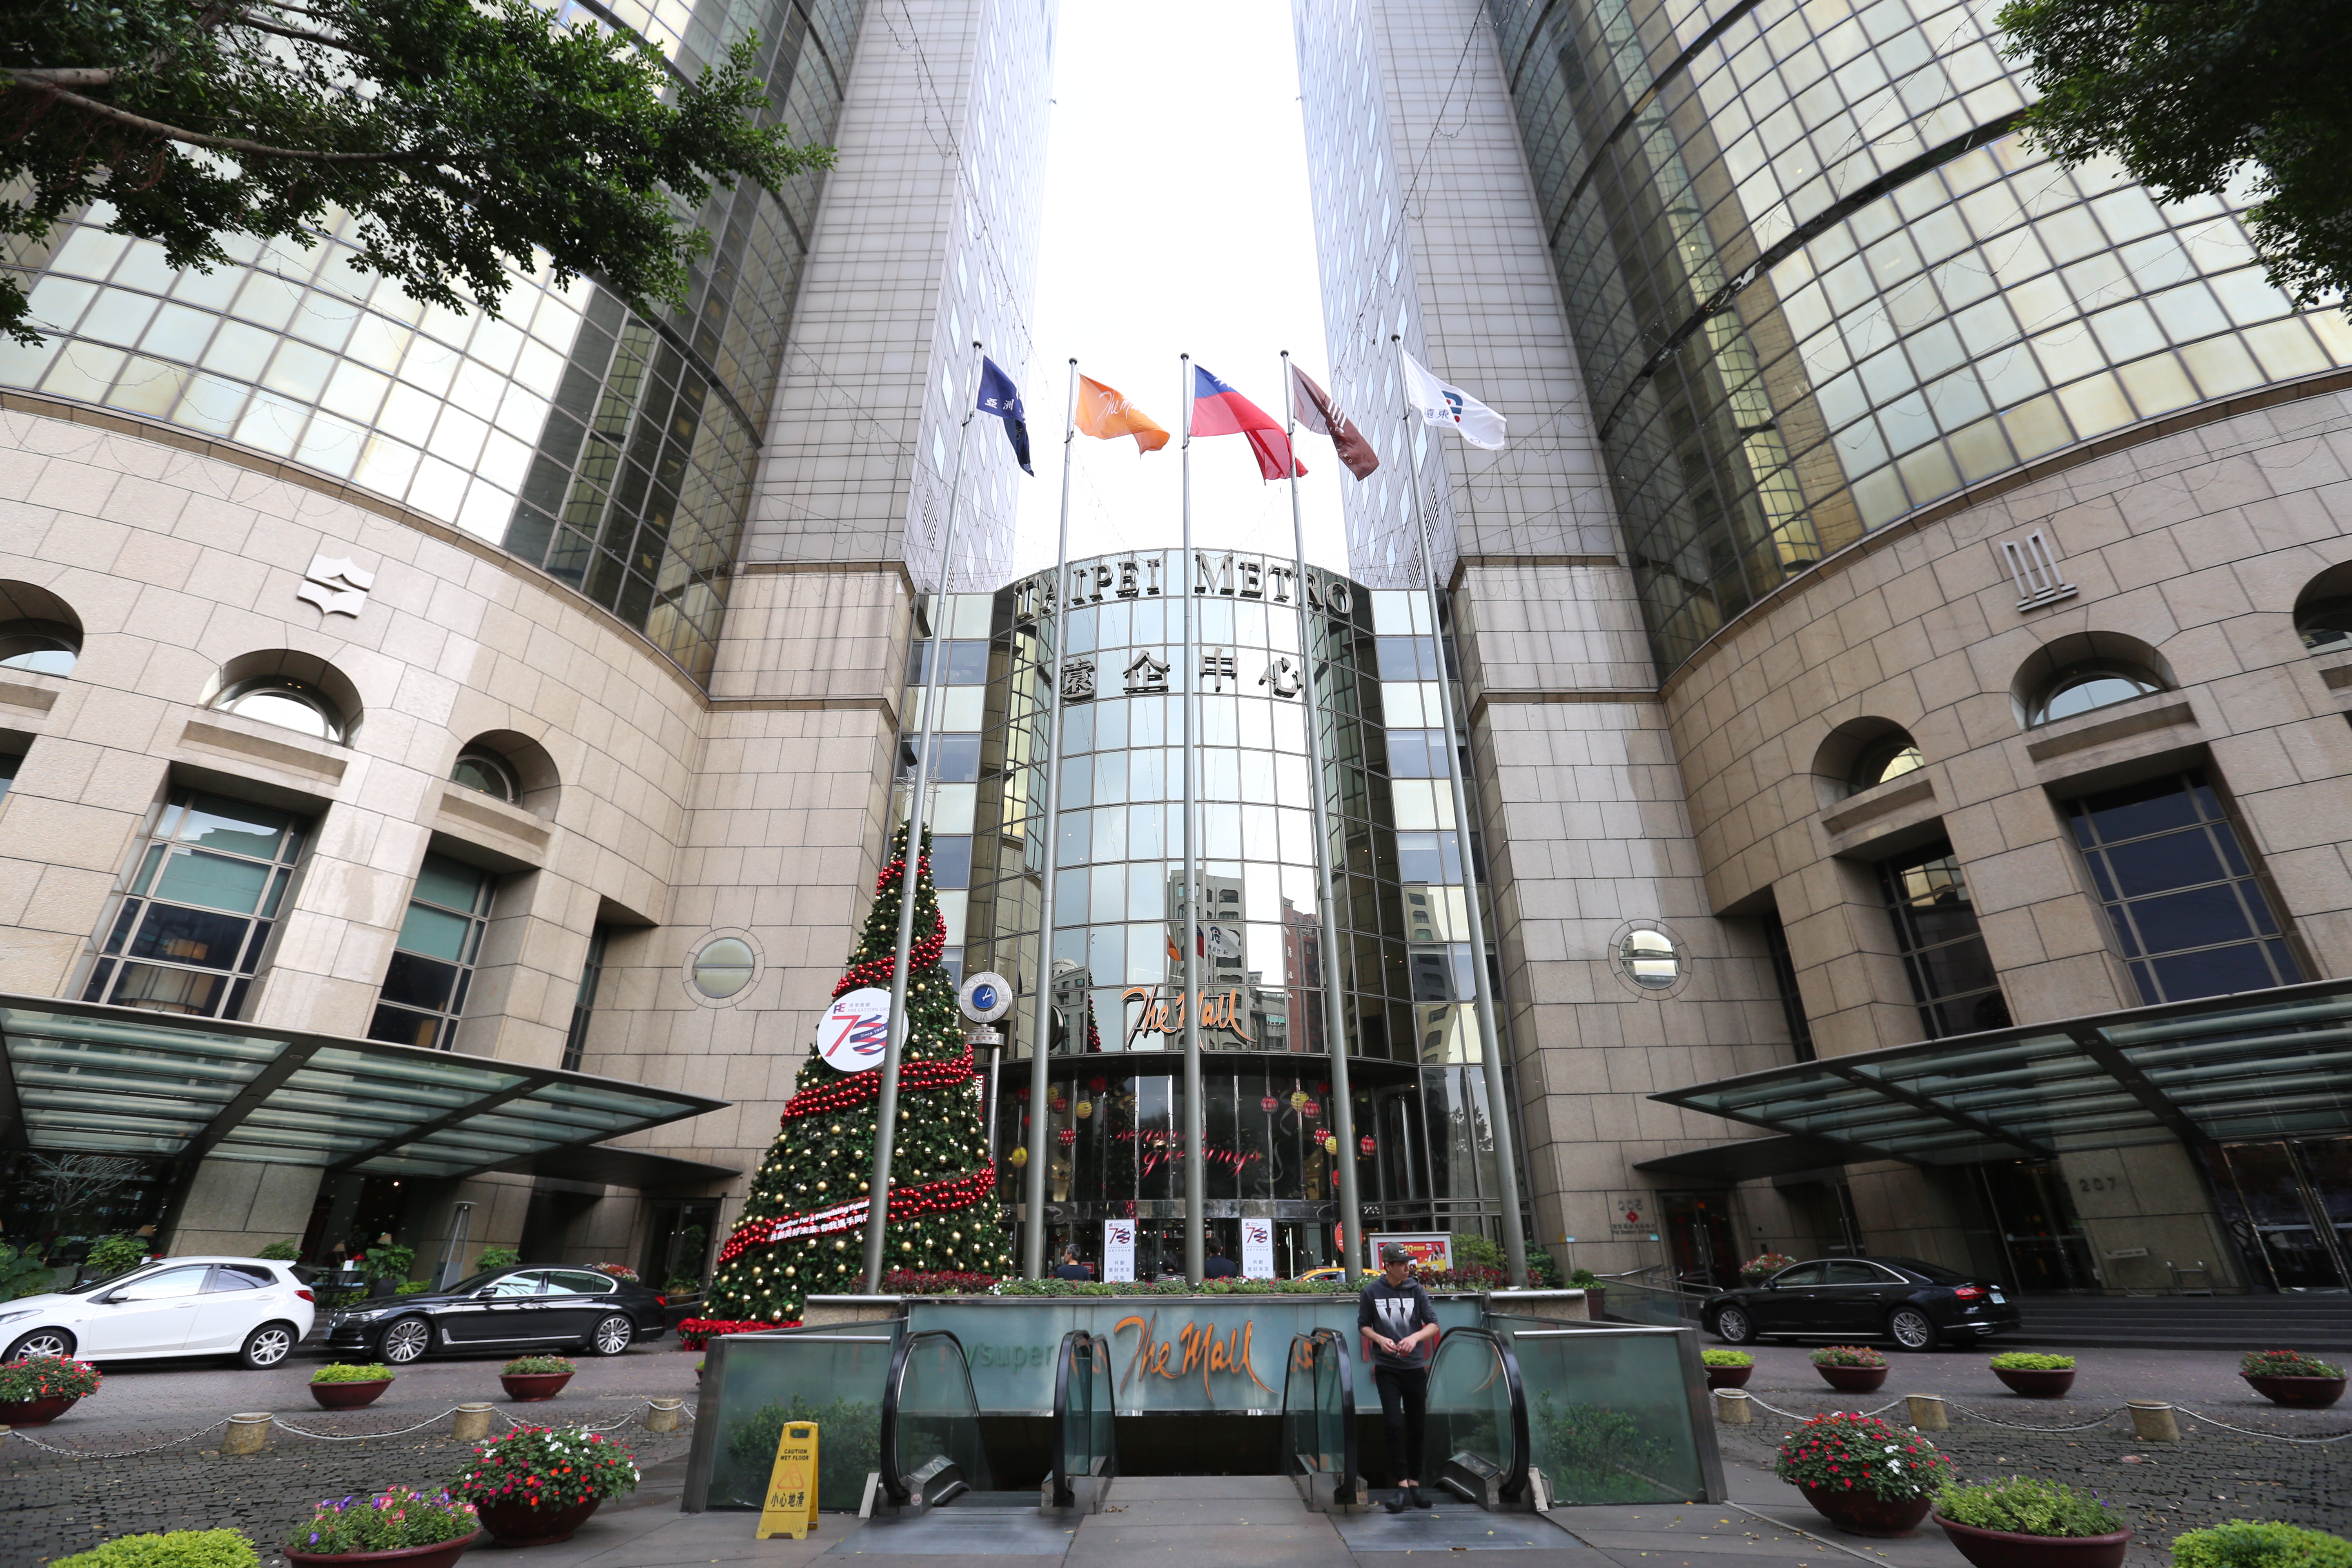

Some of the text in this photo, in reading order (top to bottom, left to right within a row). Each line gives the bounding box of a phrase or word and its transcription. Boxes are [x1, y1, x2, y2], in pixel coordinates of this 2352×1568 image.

[1014, 552, 1353, 621] TAIPEI METRO
[1061, 647, 1304, 703] 遠企中心
[874, 1025, 885, 1034] 1949
[1120, 982, 1178, 1051] The
[2079, 1176, 2116, 1192] 207
[775, 1219, 799, 1230] Together
[799, 1216, 810, 1224] For
[815, 1206, 849, 1221] Promising
[1114, 1309, 1180, 1396] The
[1179, 1319, 1279, 1405] Mall
[771, 1491, 805, 1508] 小心地滑
